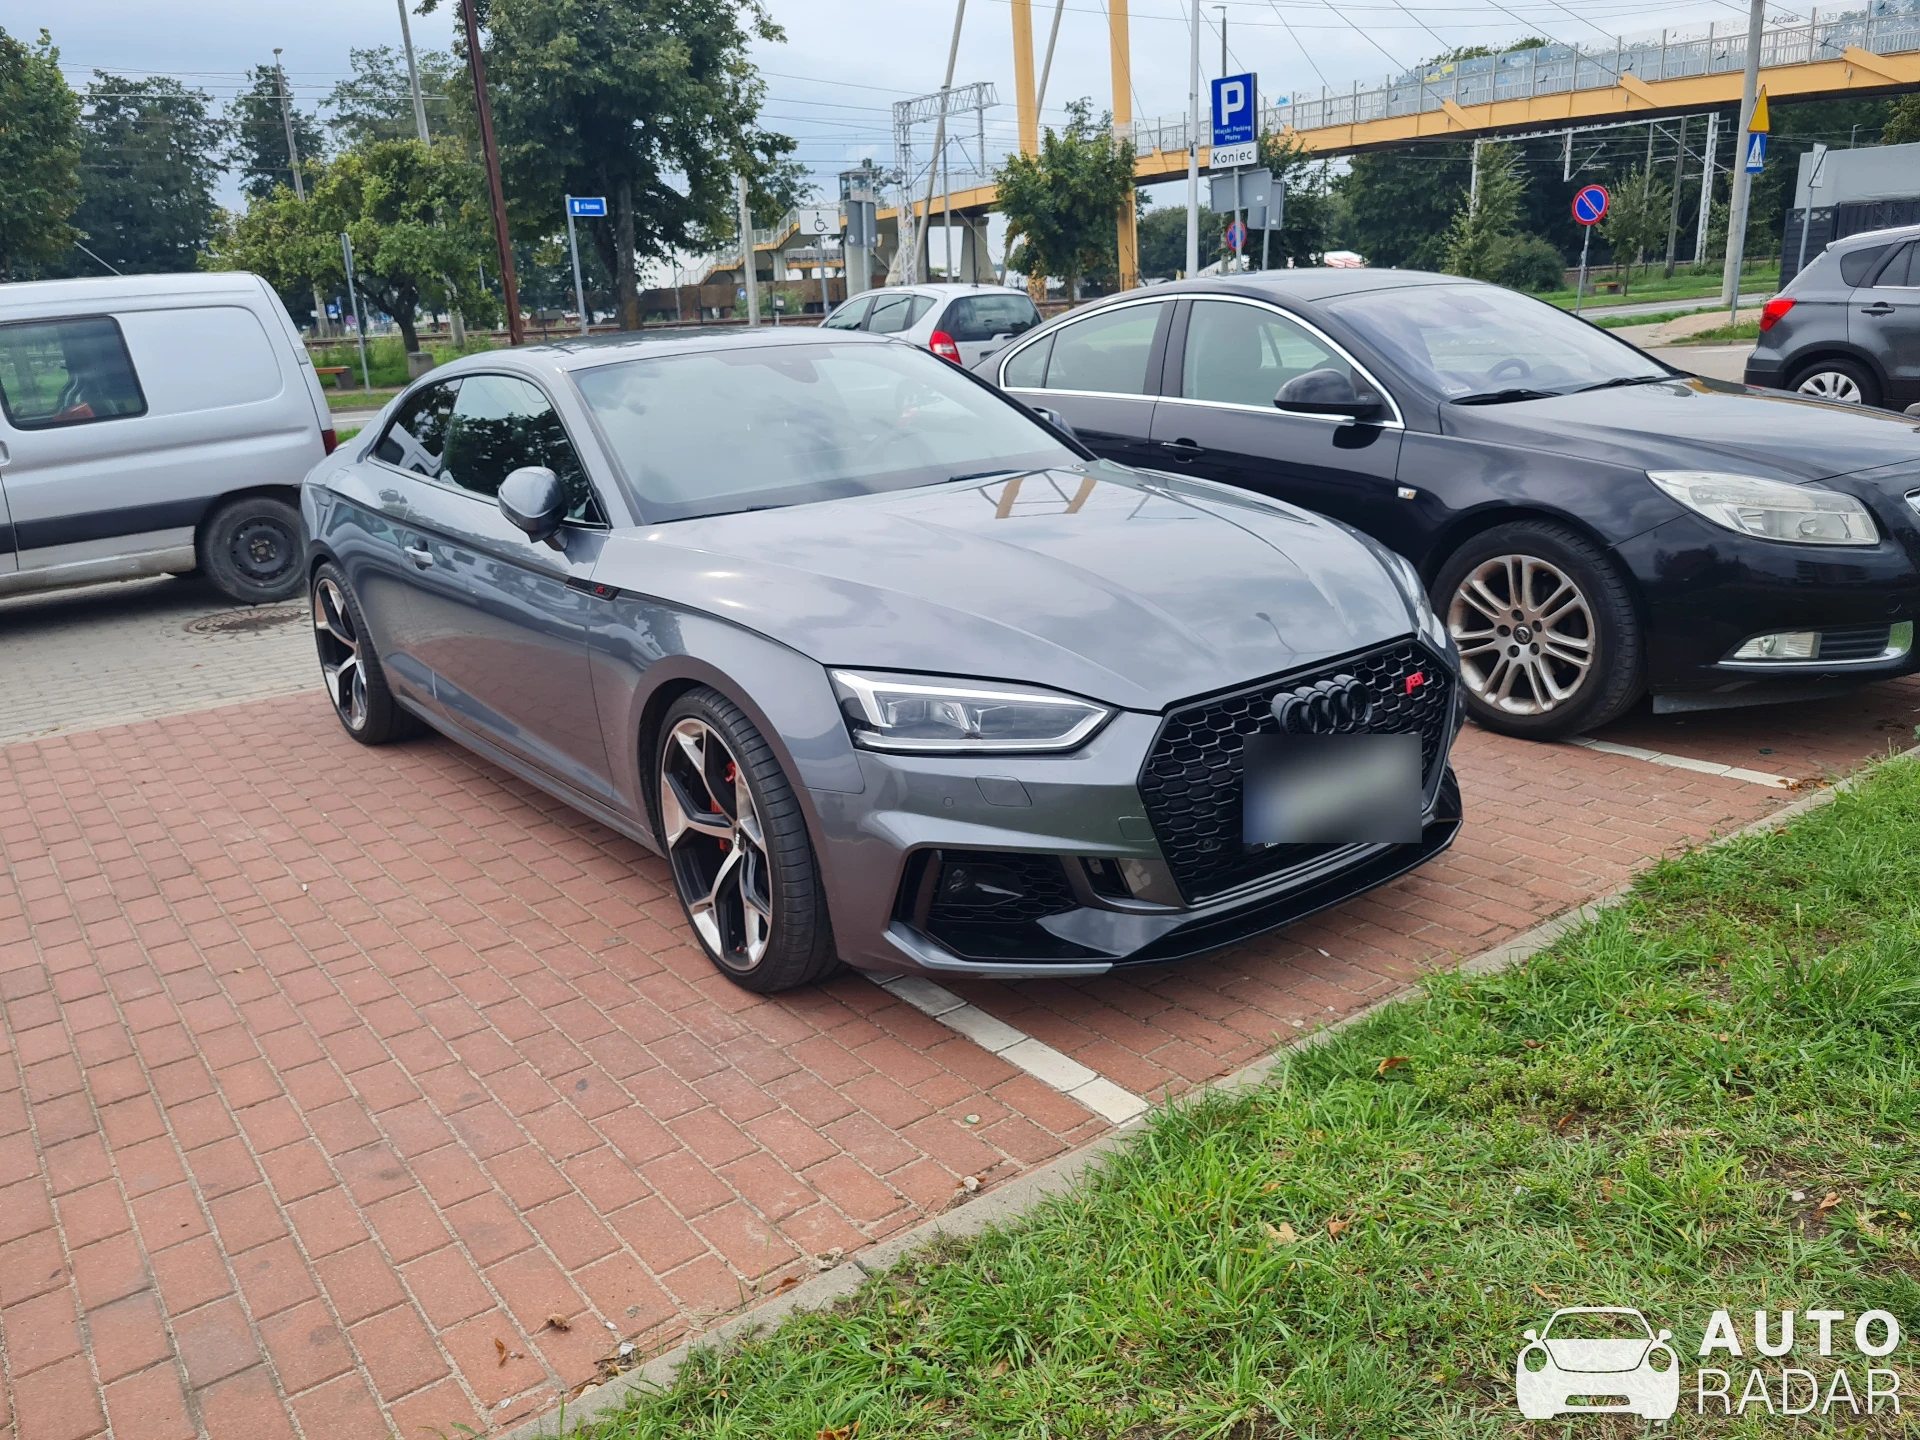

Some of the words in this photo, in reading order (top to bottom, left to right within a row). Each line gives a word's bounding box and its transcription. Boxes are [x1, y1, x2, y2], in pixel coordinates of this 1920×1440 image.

[1220, 81, 1244, 125] P
[1214, 127, 1232, 136] Miejski
[1213, 149, 1252, 165] Koniec
